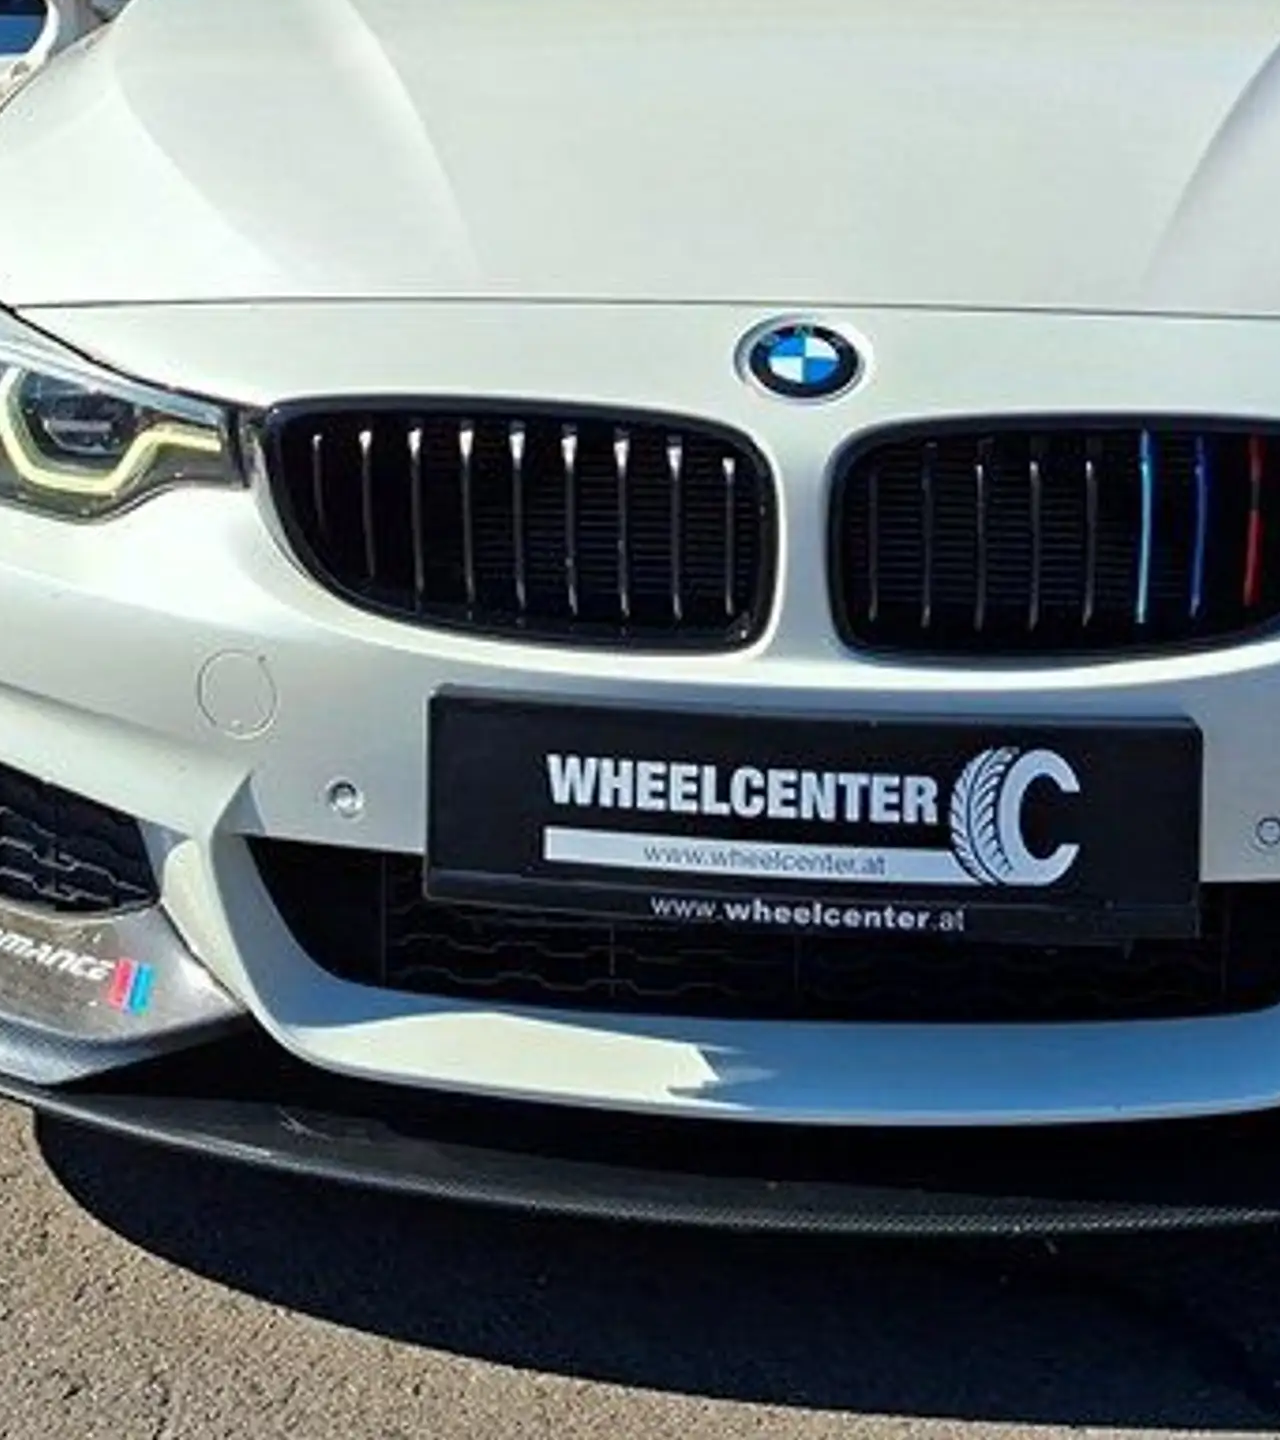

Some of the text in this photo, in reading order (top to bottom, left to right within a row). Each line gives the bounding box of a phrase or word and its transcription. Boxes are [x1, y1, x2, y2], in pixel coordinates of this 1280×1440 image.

[546, 753, 939, 824] WHEELCENTER
[643, 844, 887, 876] www.wheelcenter.at
[650, 896, 966, 933] www.wheelcenter.at
